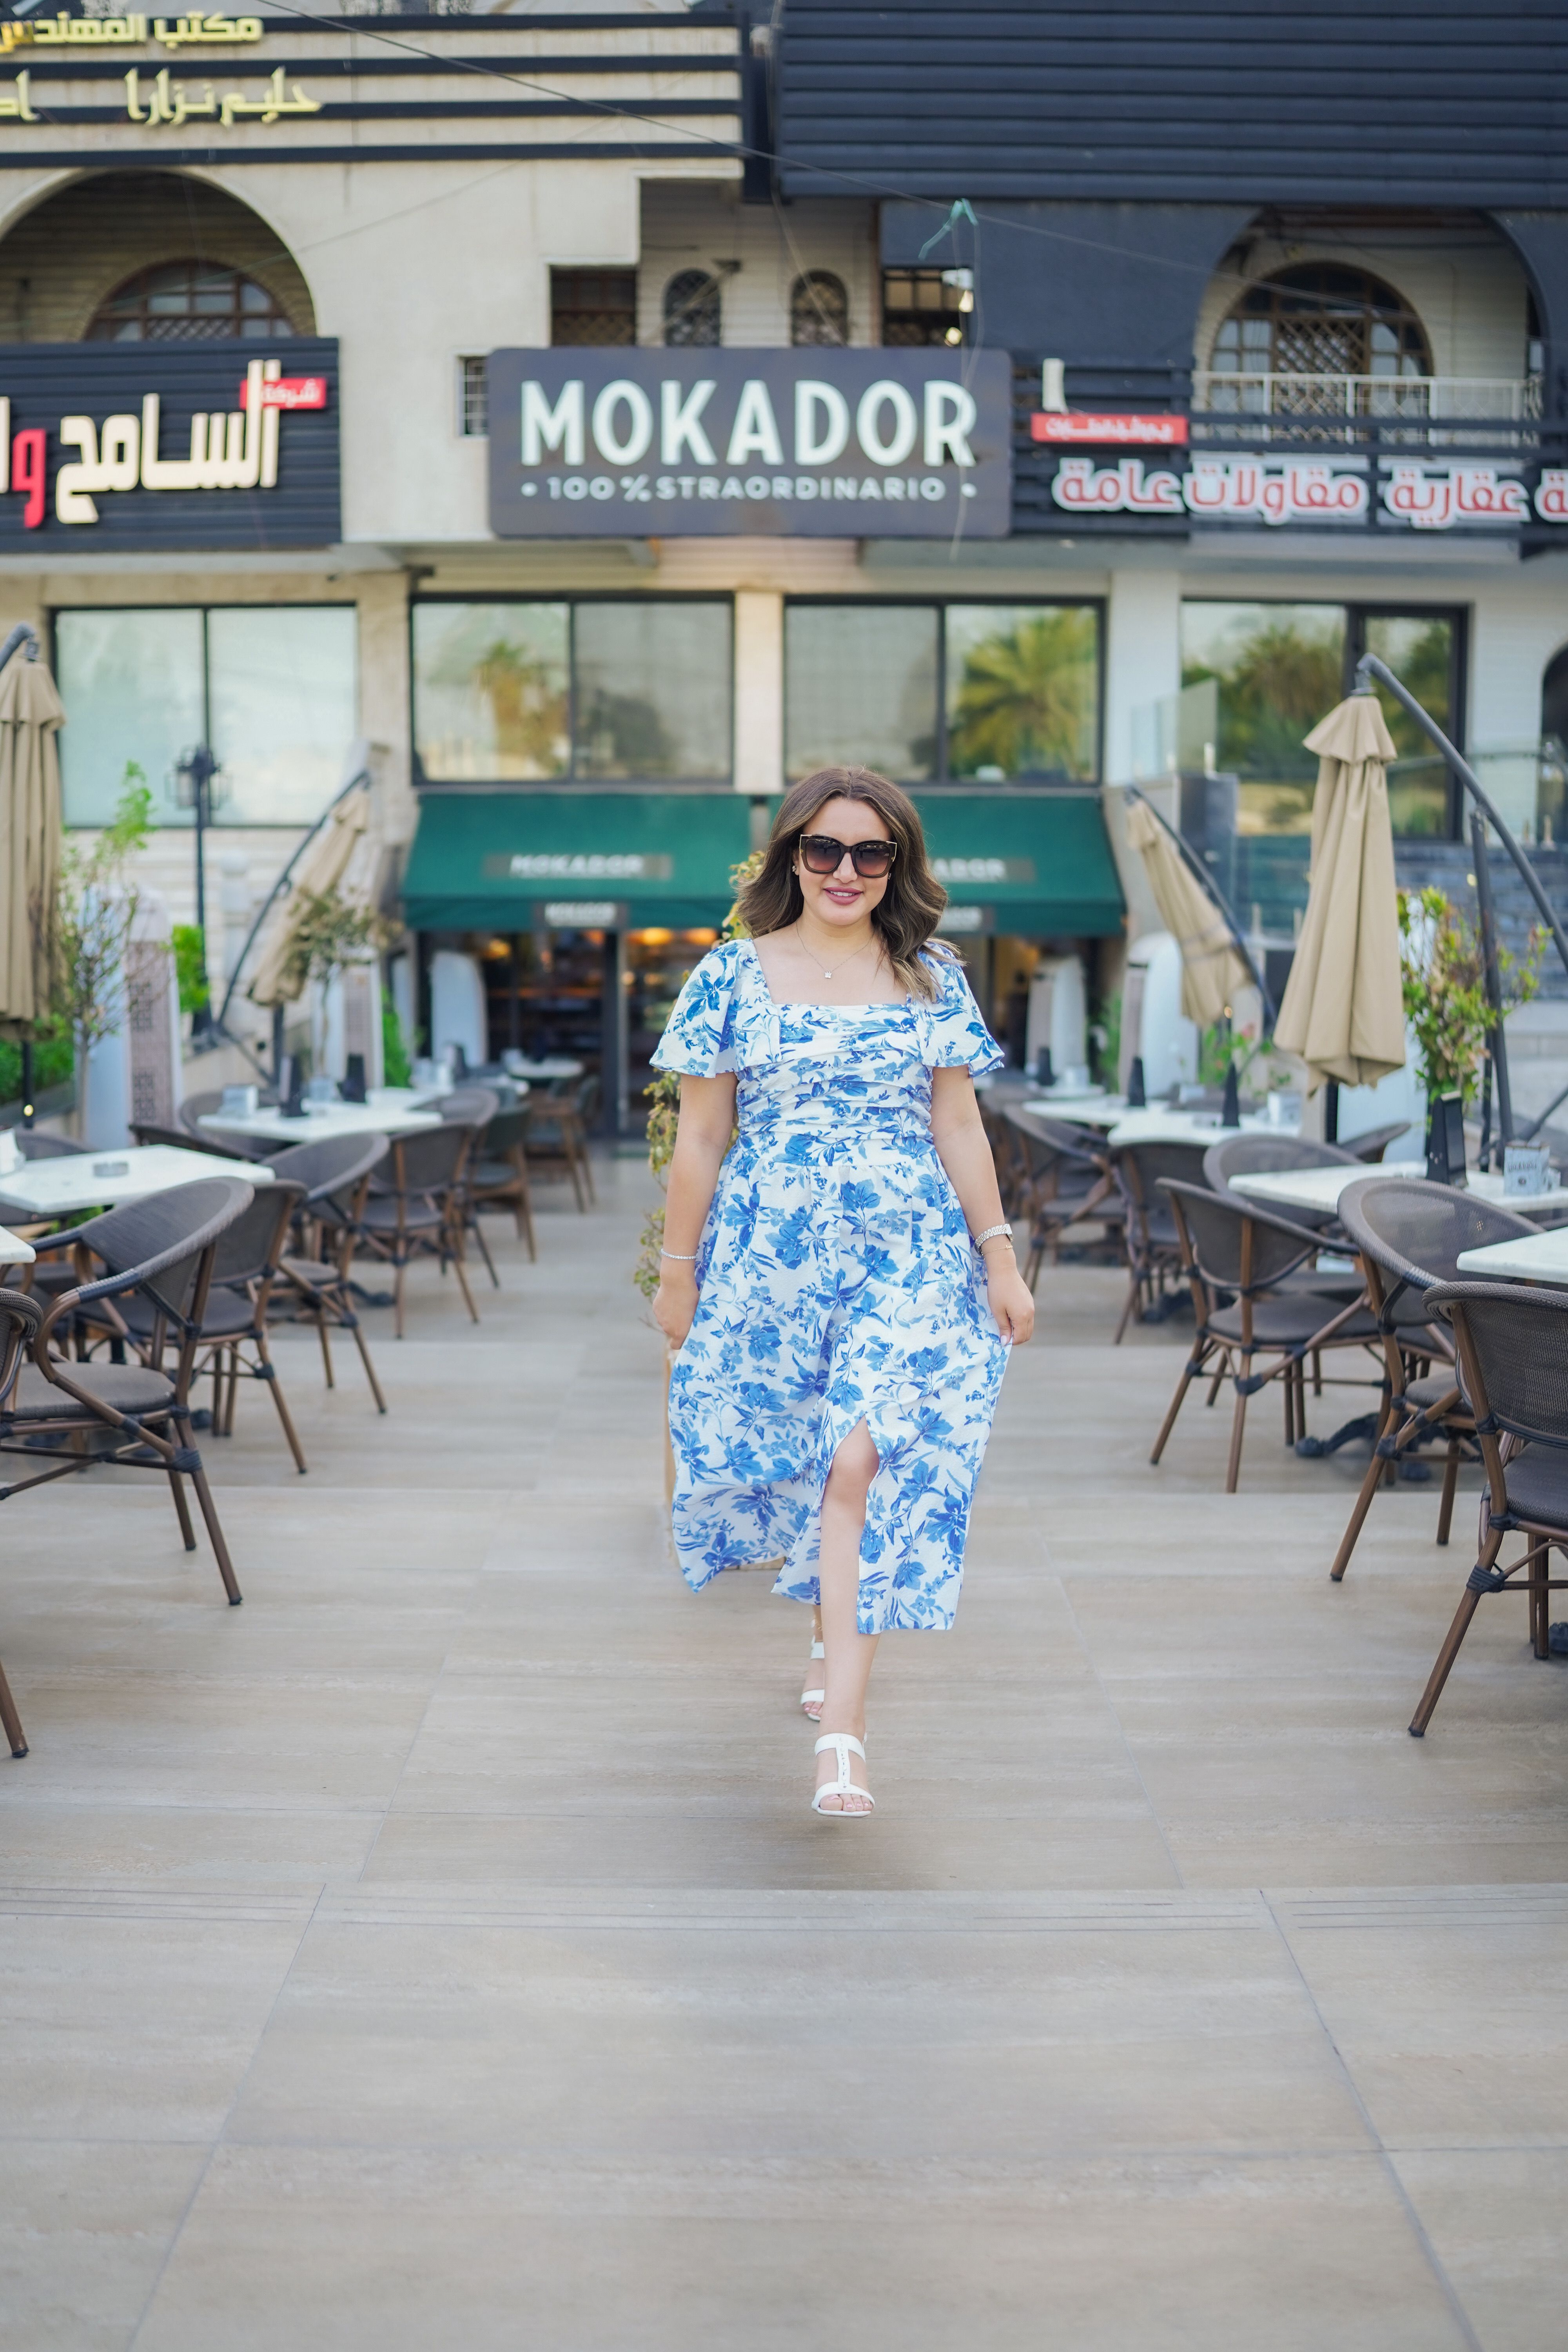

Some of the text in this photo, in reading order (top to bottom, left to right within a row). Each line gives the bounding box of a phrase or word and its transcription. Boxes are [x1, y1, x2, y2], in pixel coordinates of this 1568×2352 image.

[154, 11, 263, 49] مكتب
[220, 65, 322, 127] حليم
[56, 359, 281, 524] السامح
[521, 379, 977, 466] MOKADOR
[1054, 459, 1183, 510] عامة
[1186, 461, 1366, 523] مقاولات
[1387, 466, 1527, 528] عقارية
